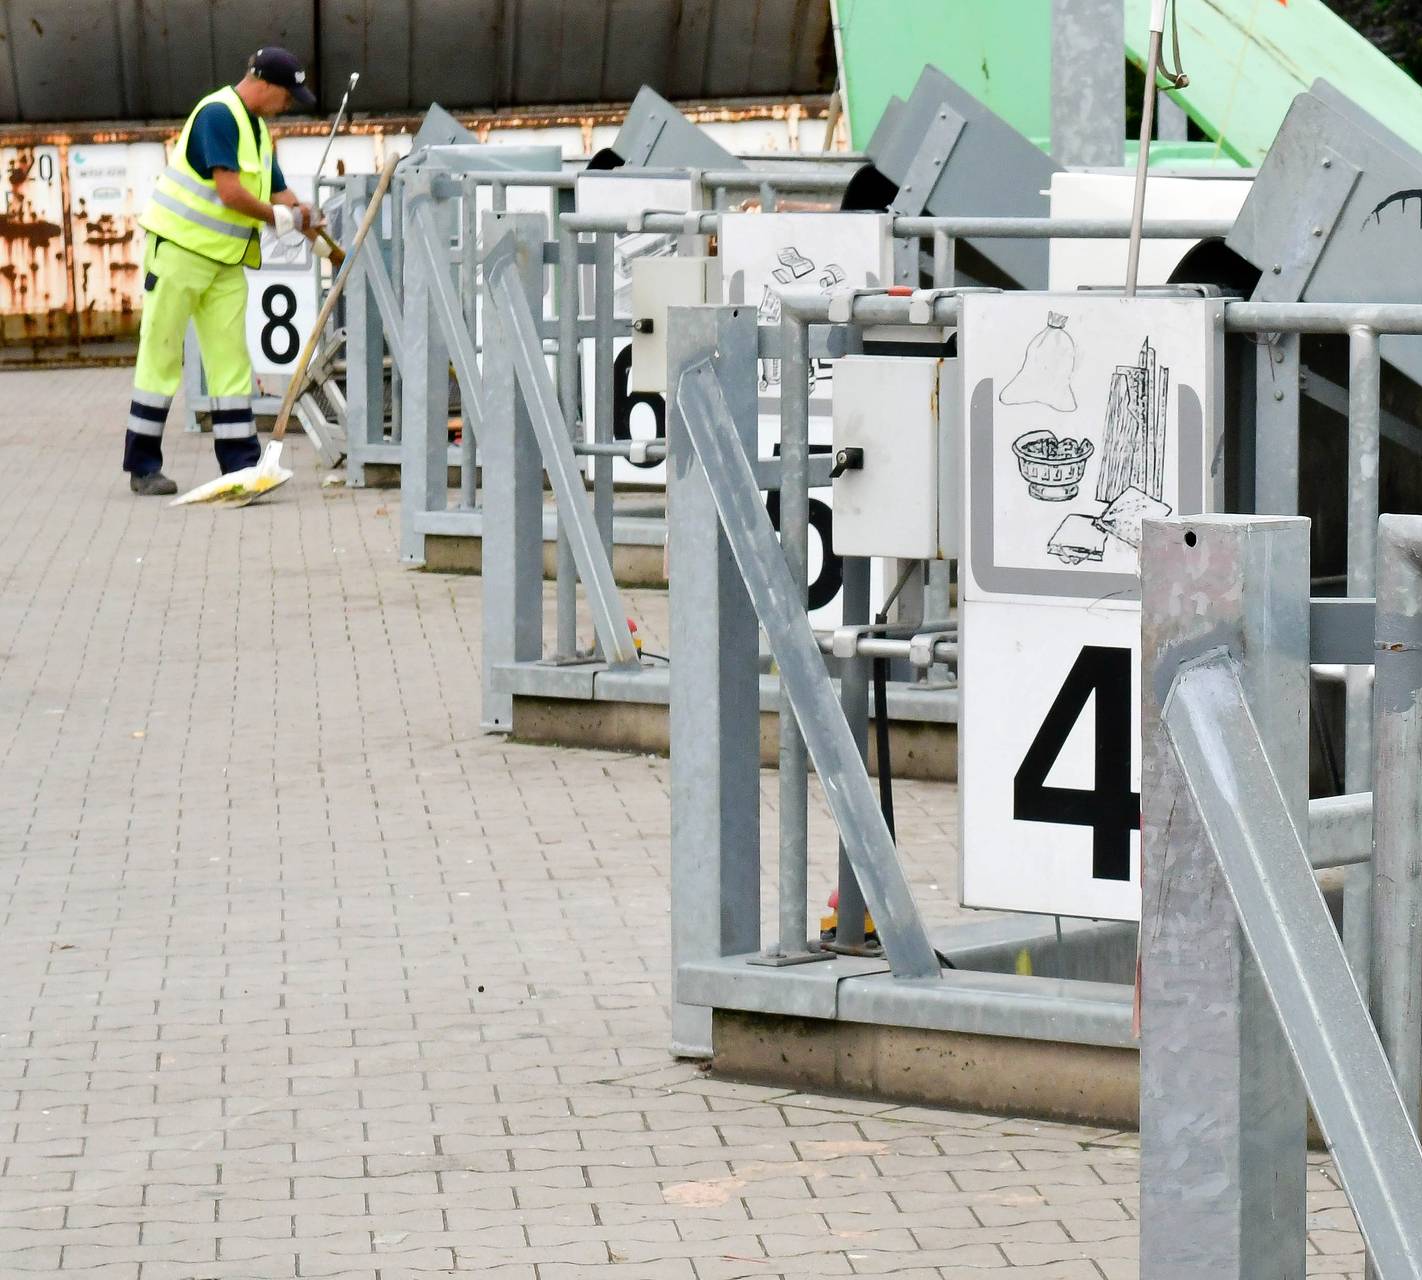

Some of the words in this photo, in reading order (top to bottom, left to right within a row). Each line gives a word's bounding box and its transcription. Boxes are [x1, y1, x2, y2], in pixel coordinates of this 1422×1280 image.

[261, 284, 300, 365] 8
[612, 343, 667, 468] 6
[1013, 645, 1141, 881] 4
